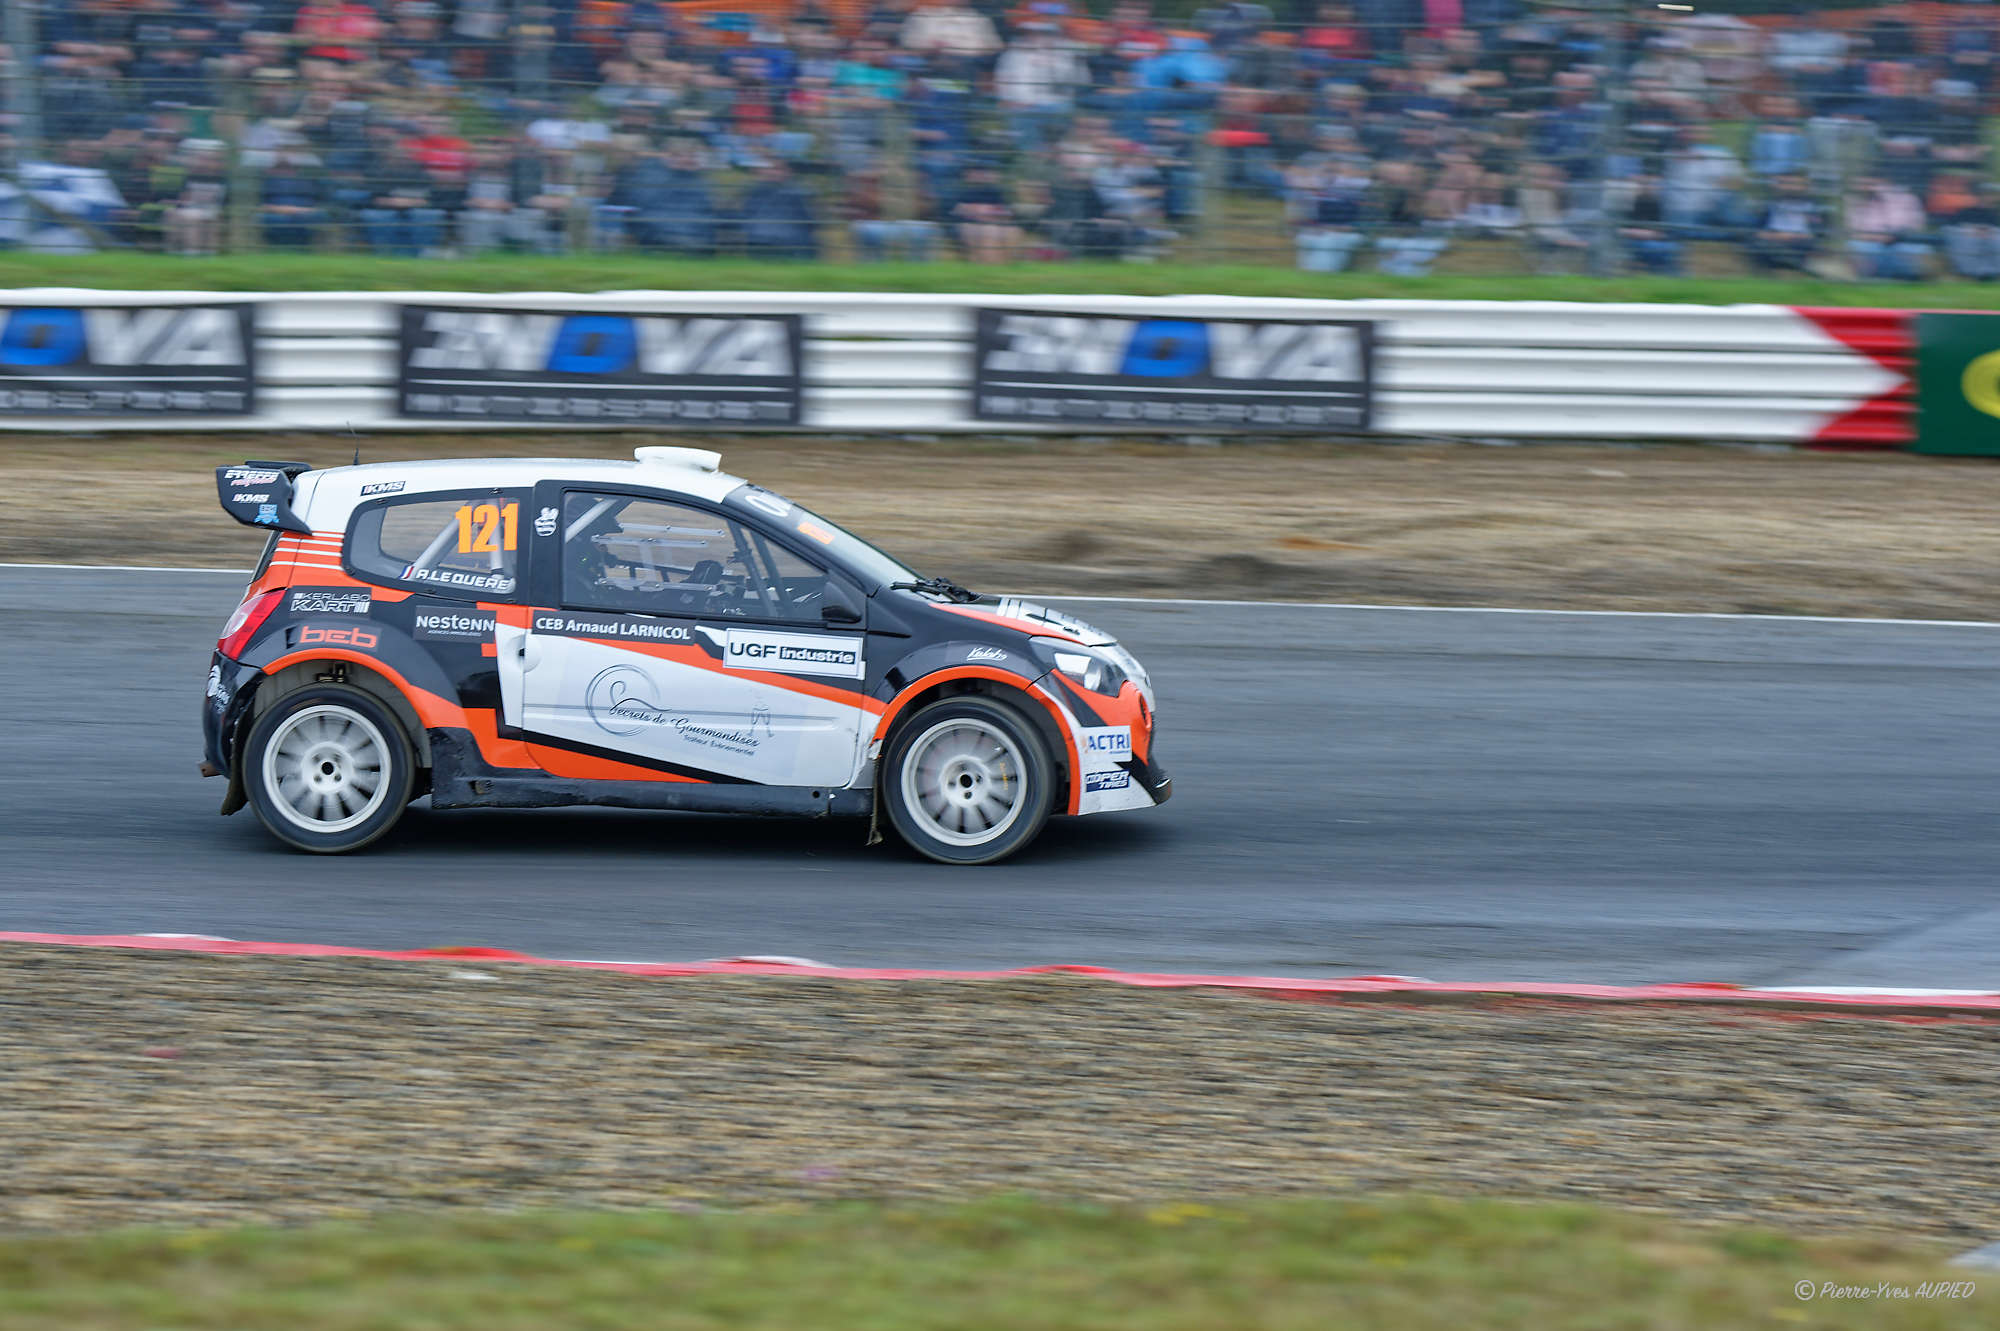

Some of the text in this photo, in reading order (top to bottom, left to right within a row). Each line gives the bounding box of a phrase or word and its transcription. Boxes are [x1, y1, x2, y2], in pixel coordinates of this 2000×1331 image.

[456, 503, 518, 553] 121
[536, 617, 691, 640] CEB Arnaud LARNICOL
[730, 642, 777, 658] UGF
